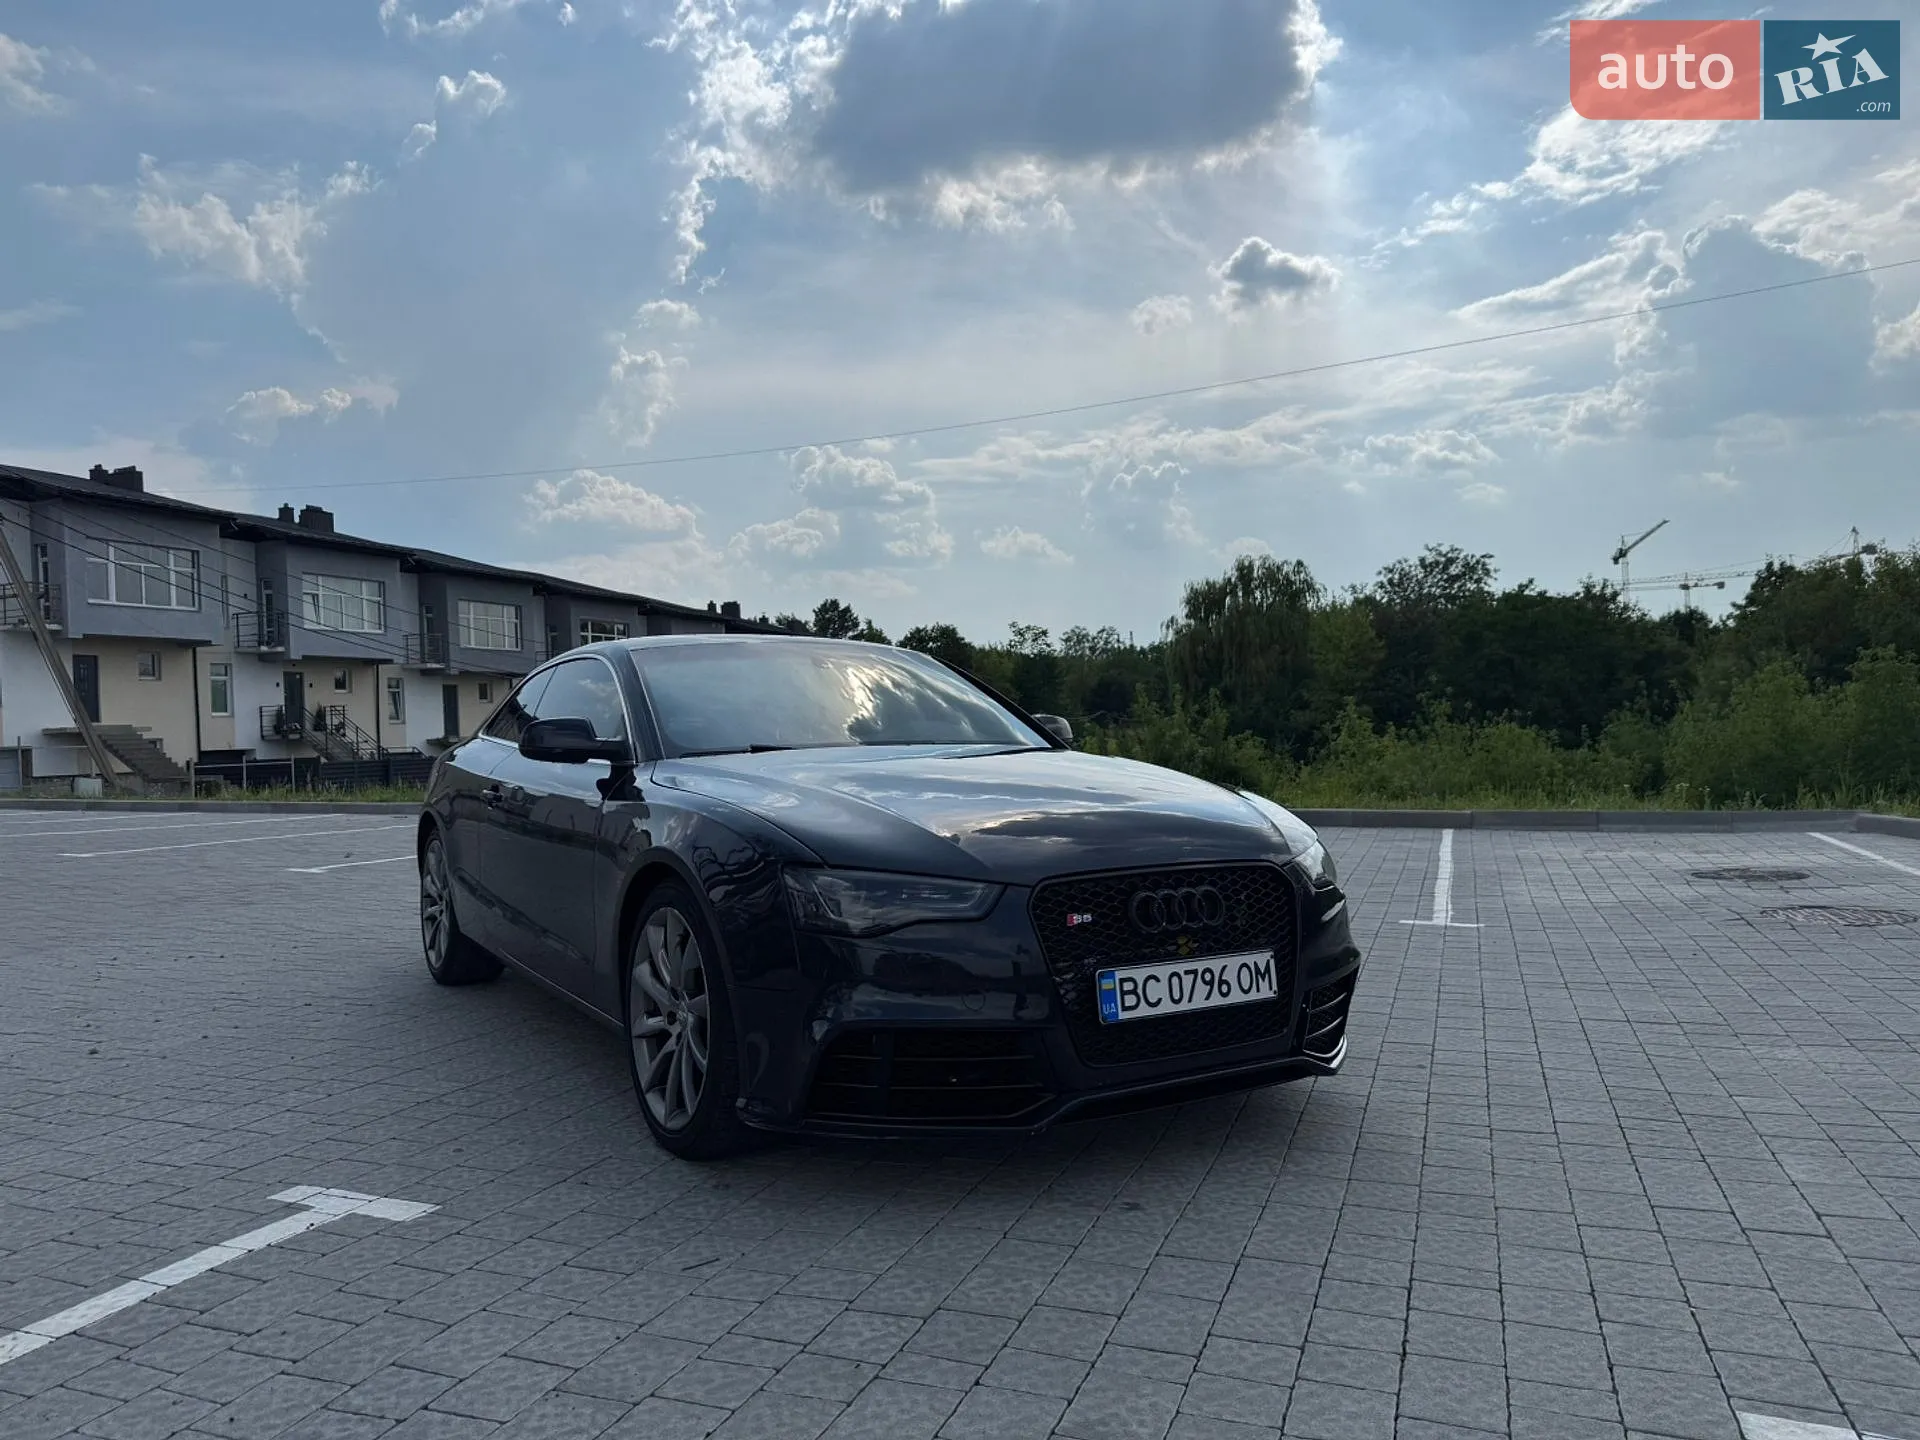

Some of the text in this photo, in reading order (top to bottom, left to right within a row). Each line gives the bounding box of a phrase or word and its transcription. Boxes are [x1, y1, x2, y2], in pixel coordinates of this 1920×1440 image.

[1118, 958, 1273, 1012] BC 0796 OM
[1103, 1003, 1117, 1015] UA
